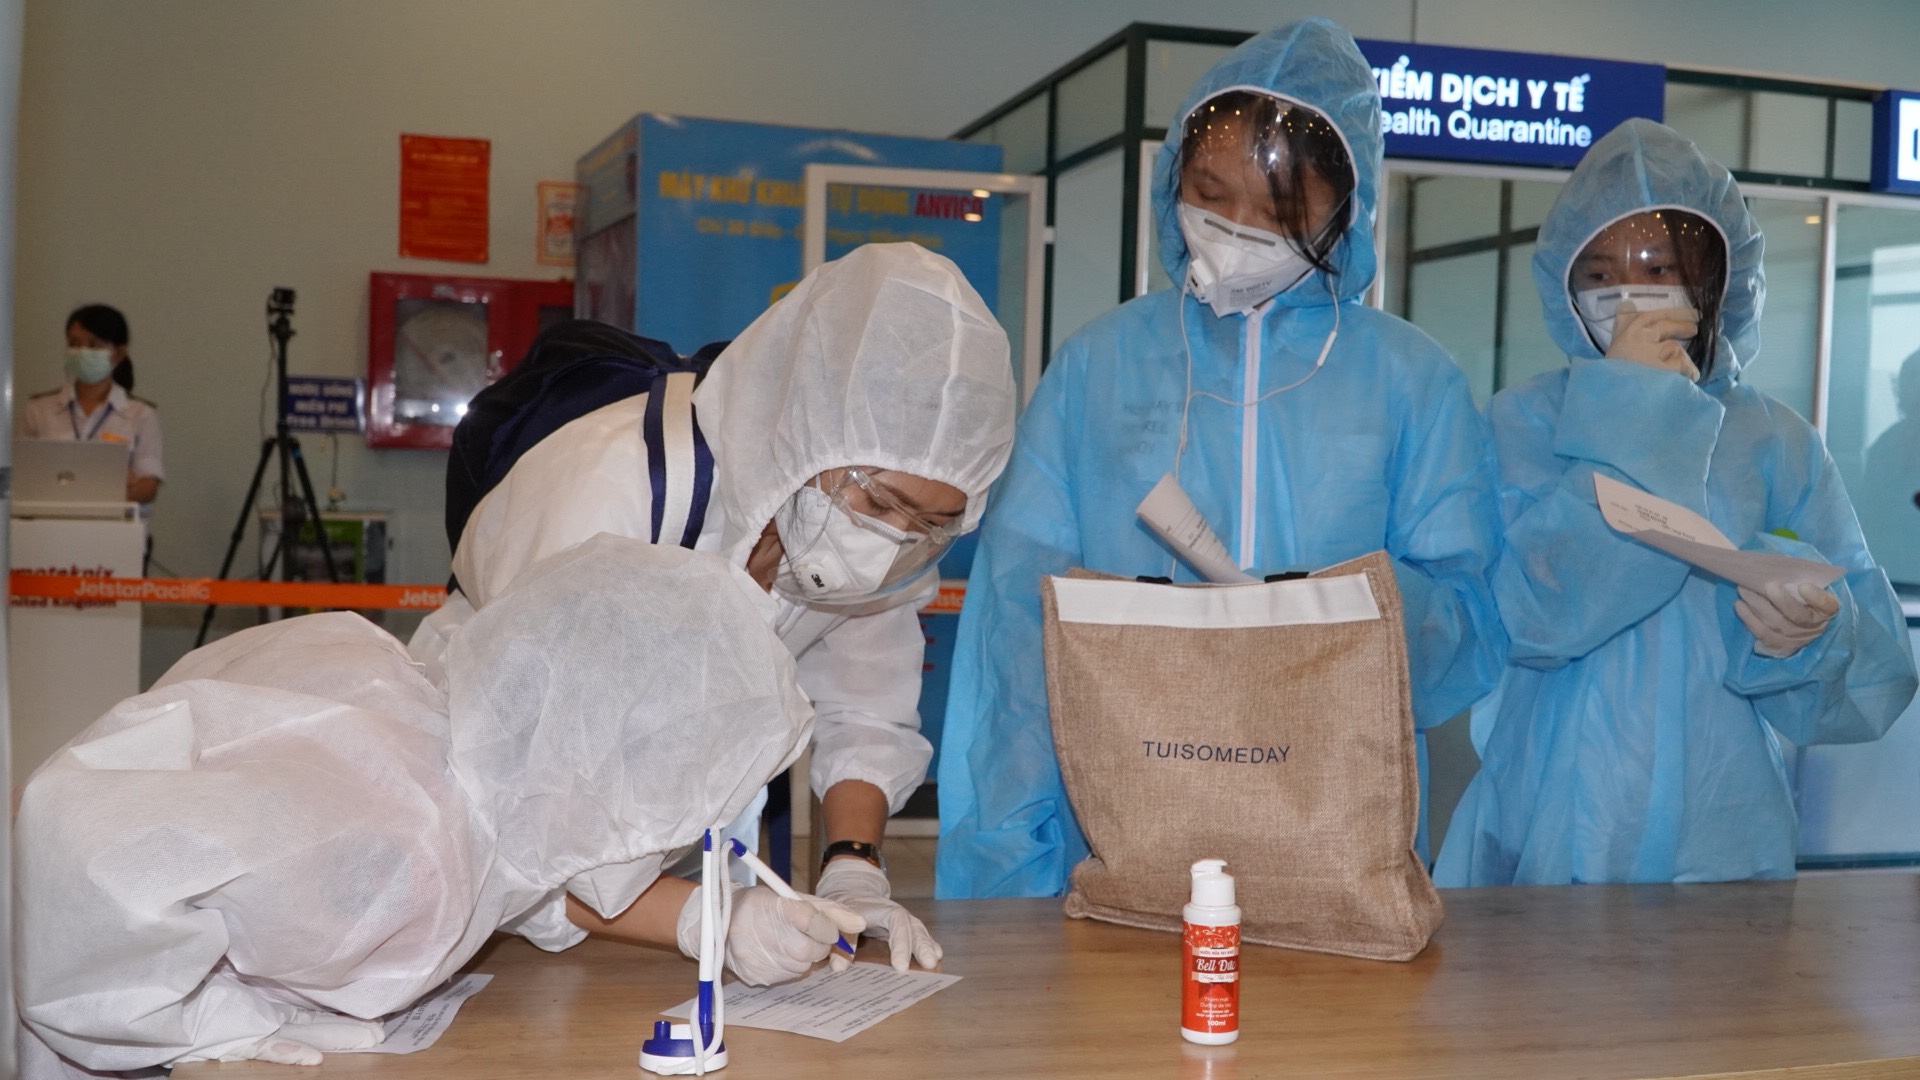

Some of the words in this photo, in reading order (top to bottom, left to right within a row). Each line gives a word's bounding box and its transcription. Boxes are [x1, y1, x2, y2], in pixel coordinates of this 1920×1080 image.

[1440, 72, 1520, 112] DỊCH
[1526, 79, 1548, 110] Y
[1553, 72, 1592, 113] TẾ
[1380, 105, 1441, 137] ealth
[1447, 109, 1593, 149] Quarantine
[811, 573, 825, 588] 3M
[1143, 741, 1290, 764] TUISOMEDAY
[1196, 959, 1216, 971] Bell
